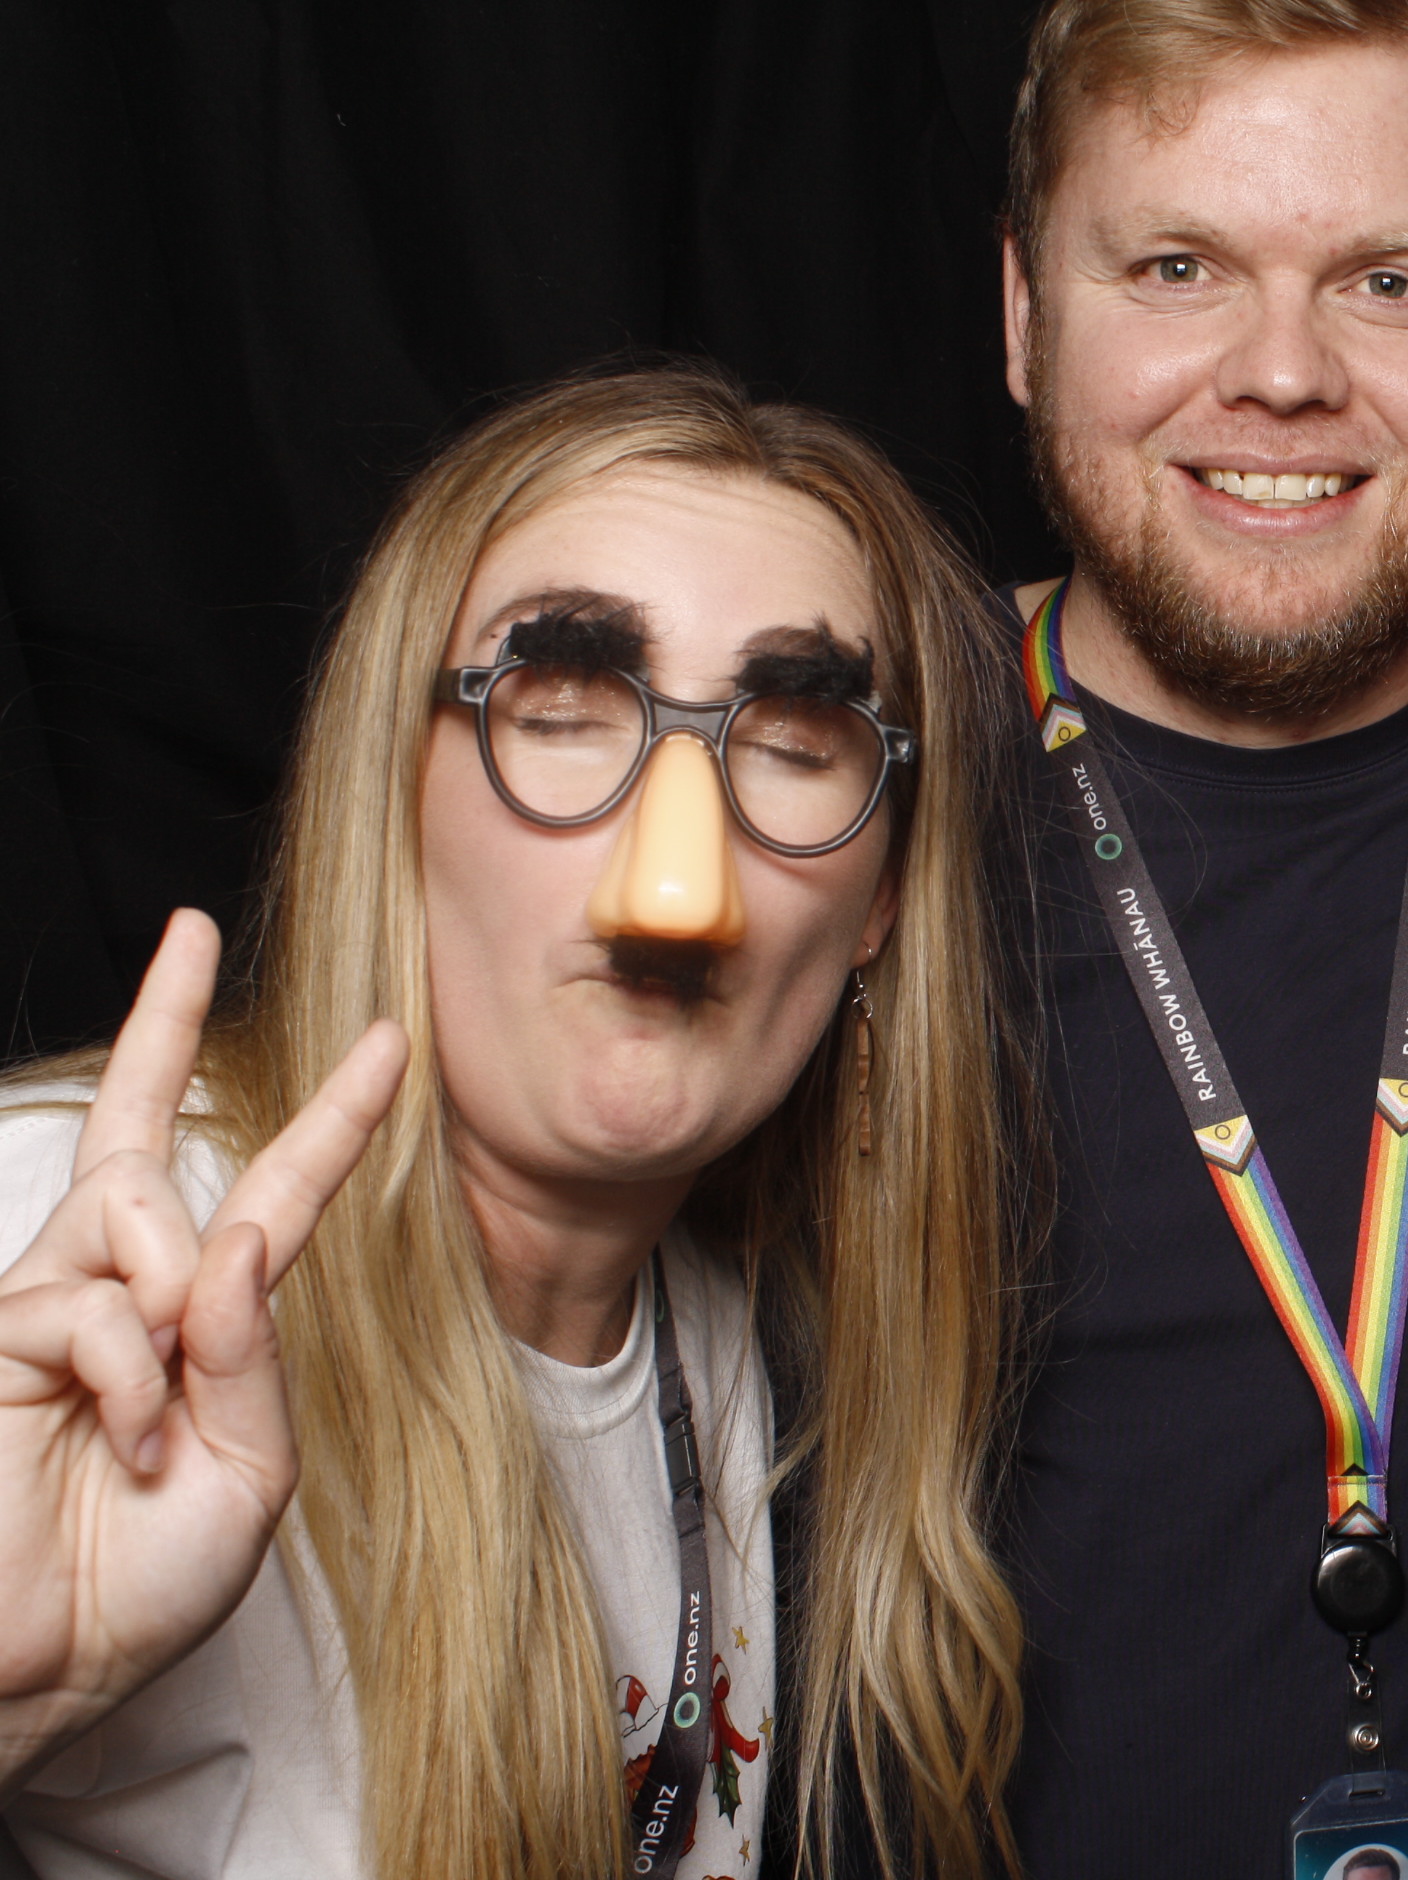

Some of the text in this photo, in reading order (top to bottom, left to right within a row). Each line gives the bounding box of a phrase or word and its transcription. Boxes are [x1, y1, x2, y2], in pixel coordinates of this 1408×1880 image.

[1072, 763, 1107, 831] one.nz
[1116, 888, 1217, 1101] RAINBOW WHĀNAU
[684, 1590, 701, 1685] one.nz
[634, 1784, 679, 1874] one.nz
